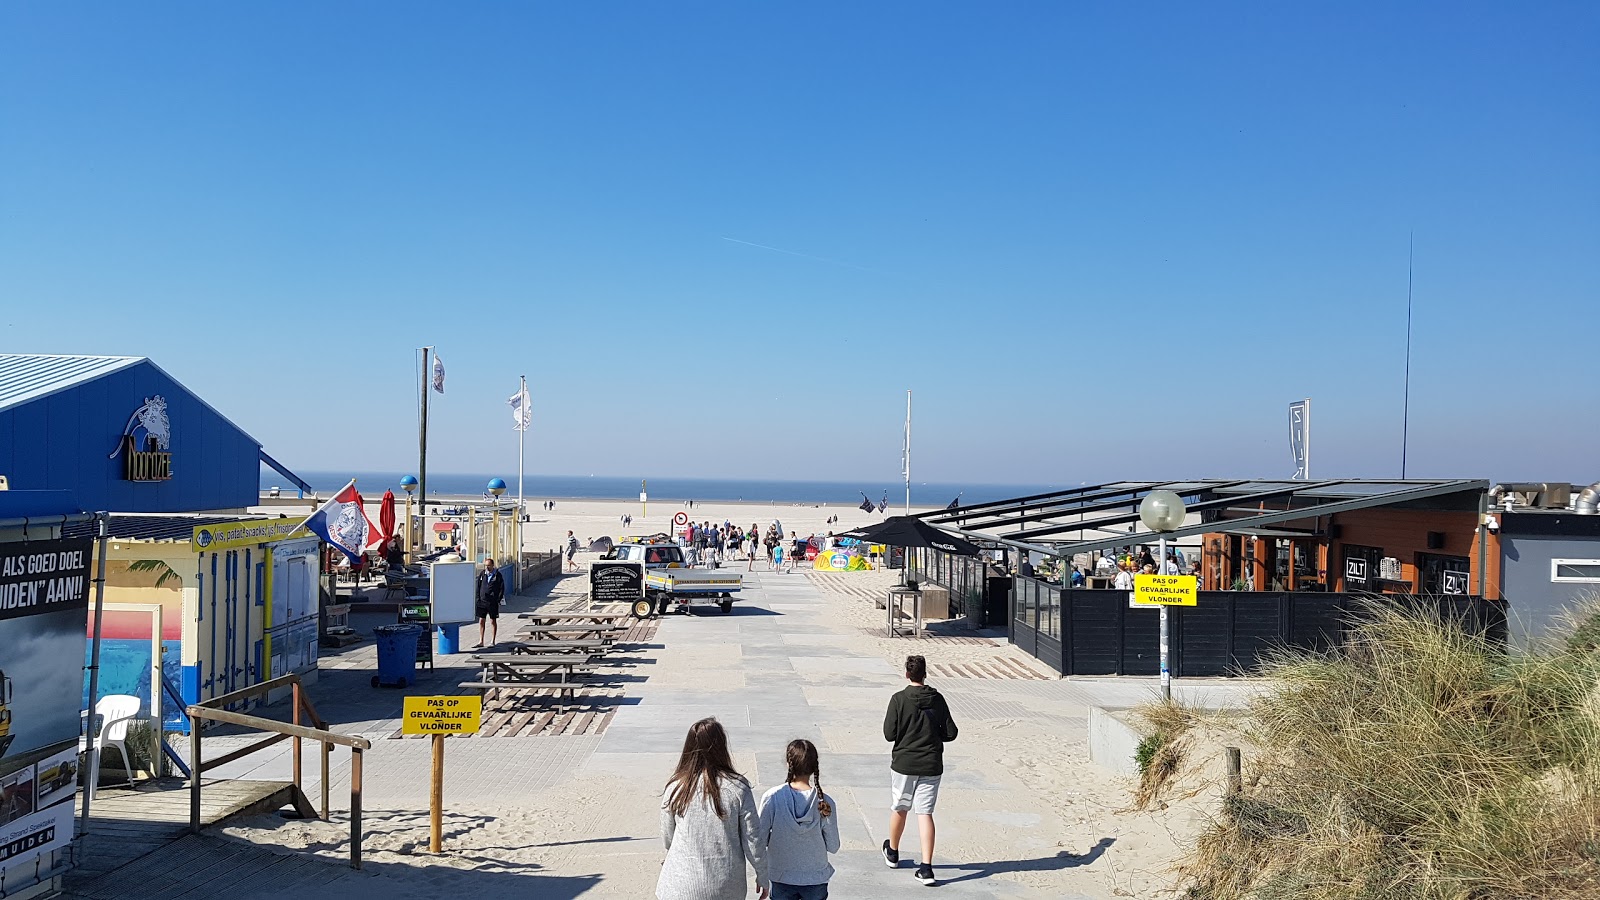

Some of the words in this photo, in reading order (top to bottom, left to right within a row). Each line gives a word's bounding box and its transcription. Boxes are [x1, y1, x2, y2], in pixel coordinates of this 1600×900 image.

[2, 555, 25, 577] ALS
[28, 552, 57, 574] GOED
[59, 551, 85, 571] DOEL
[1348, 562, 1365, 576] ZILT
[45, 575, 84, 604] AAN!!
[1140, 586, 1190, 594] GEVAARLIJKE
[1446, 575, 1467, 591] ZILT
[427, 699, 444, 707] PAS
[446, 699, 459, 707] OP
[410, 711, 472, 719] GEVAARLIJKE
[9, 826, 29, 839] Strand
[29, 817, 56, 832] Spektakel
